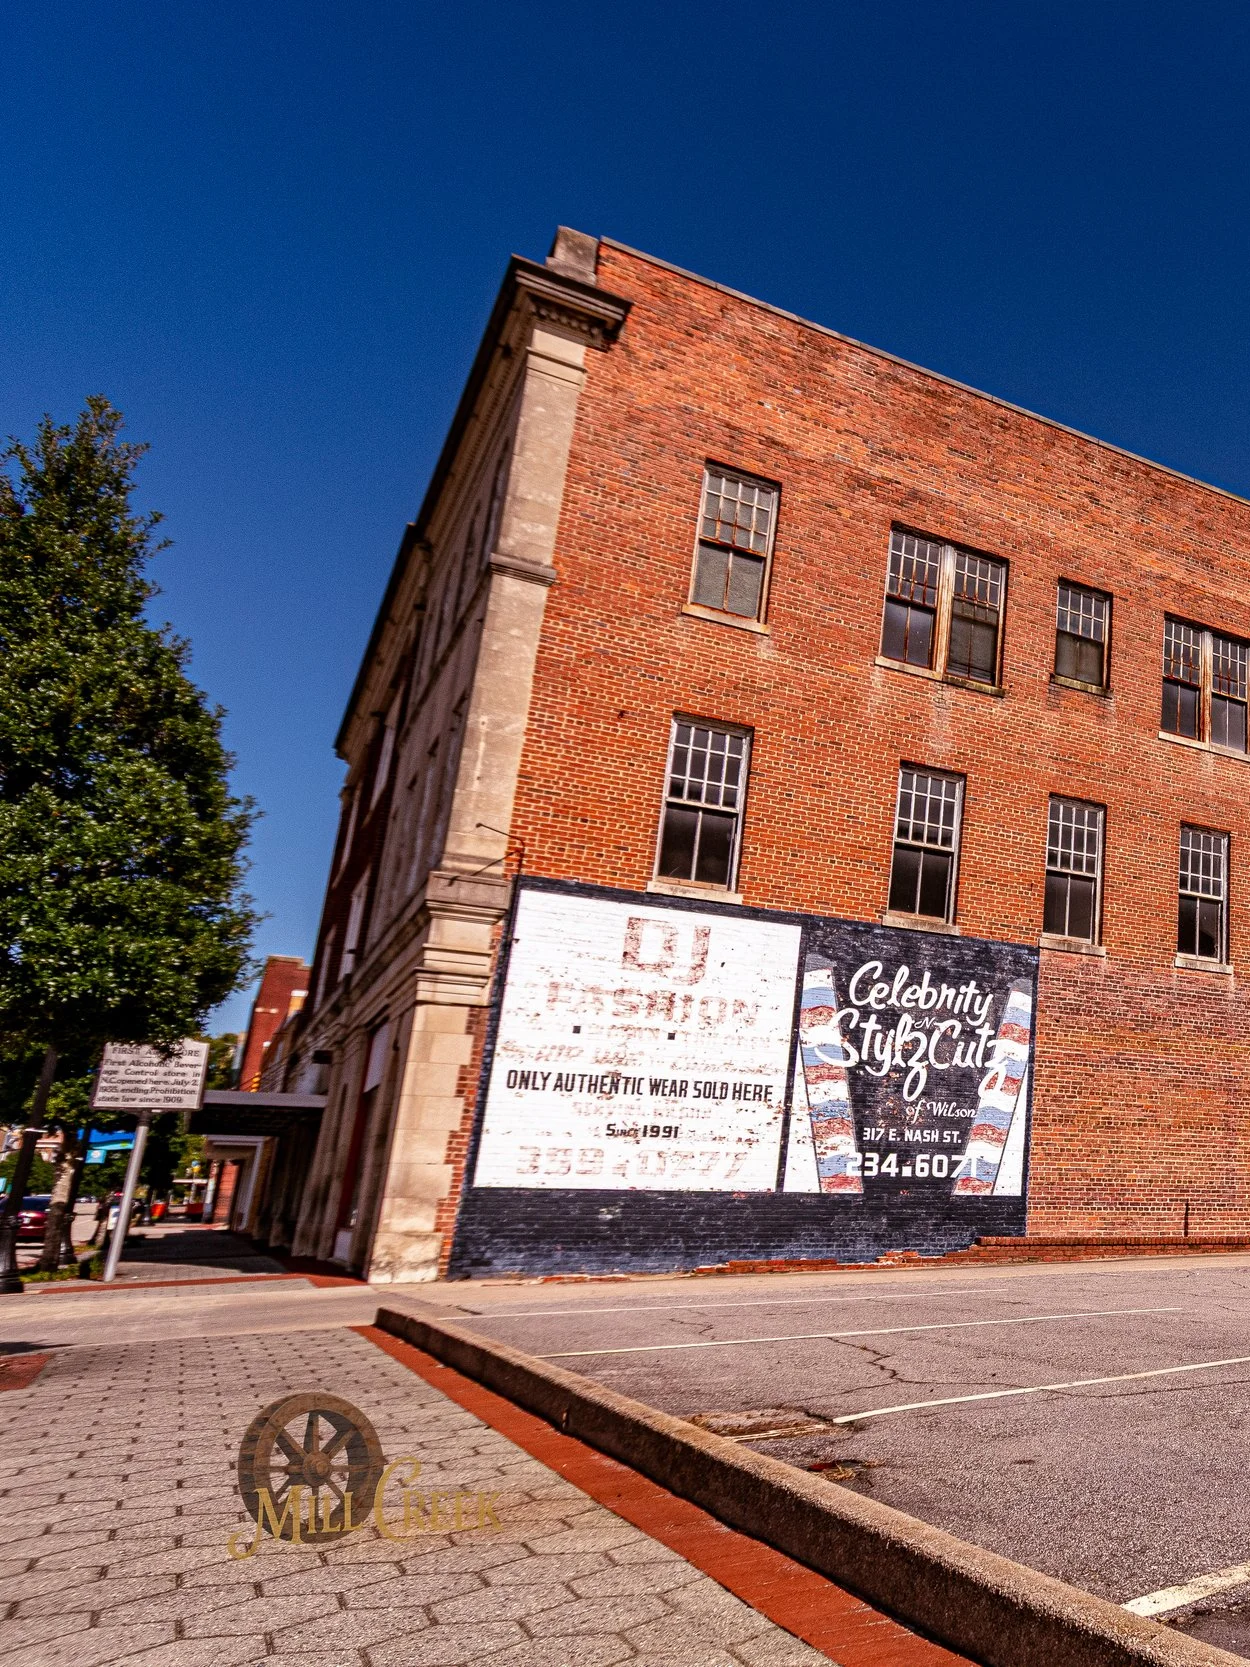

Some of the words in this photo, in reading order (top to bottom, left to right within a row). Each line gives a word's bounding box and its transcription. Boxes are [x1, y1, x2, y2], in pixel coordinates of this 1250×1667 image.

[849, 960, 994, 1026] Celebrity
[112, 1047, 140, 1055] FIRST
[814, 1007, 930, 1102] Stylz
[928, 1019, 1016, 1098] Cutz
[124, 1068, 158, 1076] Control
[171, 1079, 189, 1087] July
[506, 1069, 551, 1091] ONLY
[553, 1072, 645, 1096] AUTHENTIC
[649, 1077, 688, 1098] WEAR
[692, 1080, 728, 1100] SOLD
[731, 1082, 773, 1102] HERE
[906, 1100, 926, 1124] of
[926, 1102, 977, 1118] Wilson
[642, 1124, 679, 1138] 1991
[863, 1127, 885, 1141] 317
[888, 1128, 900, 1141] E.
[904, 1129, 939, 1142] NASH
[942, 1130, 962, 1144] ST.
